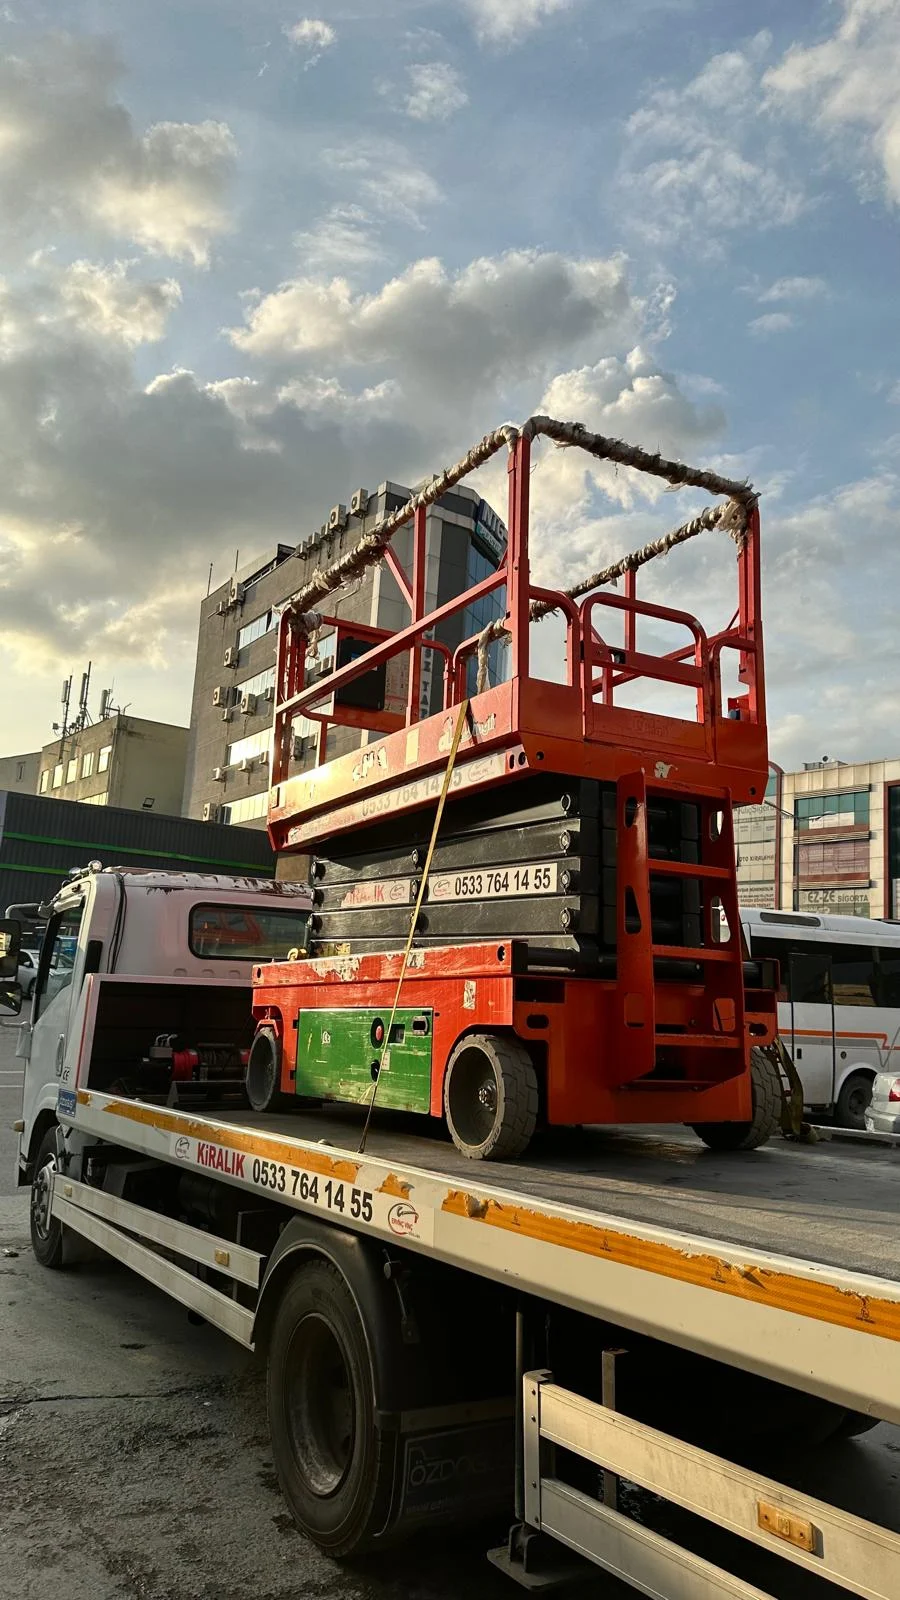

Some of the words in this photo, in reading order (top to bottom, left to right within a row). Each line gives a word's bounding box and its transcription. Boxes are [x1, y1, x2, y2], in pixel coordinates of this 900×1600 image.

[362, 796, 391, 817] 0533
[423, 779, 440, 796] 14
[455, 875, 483, 896] 0533
[487, 871, 509, 893] 764
[514, 869, 530, 891] 14
[534, 867, 551, 890] 55
[252, 1158, 286, 1192] 0533
[291, 1169, 319, 1204] 764
[324, 1180, 345, 1213] 14
[350, 1187, 373, 1222] 55
